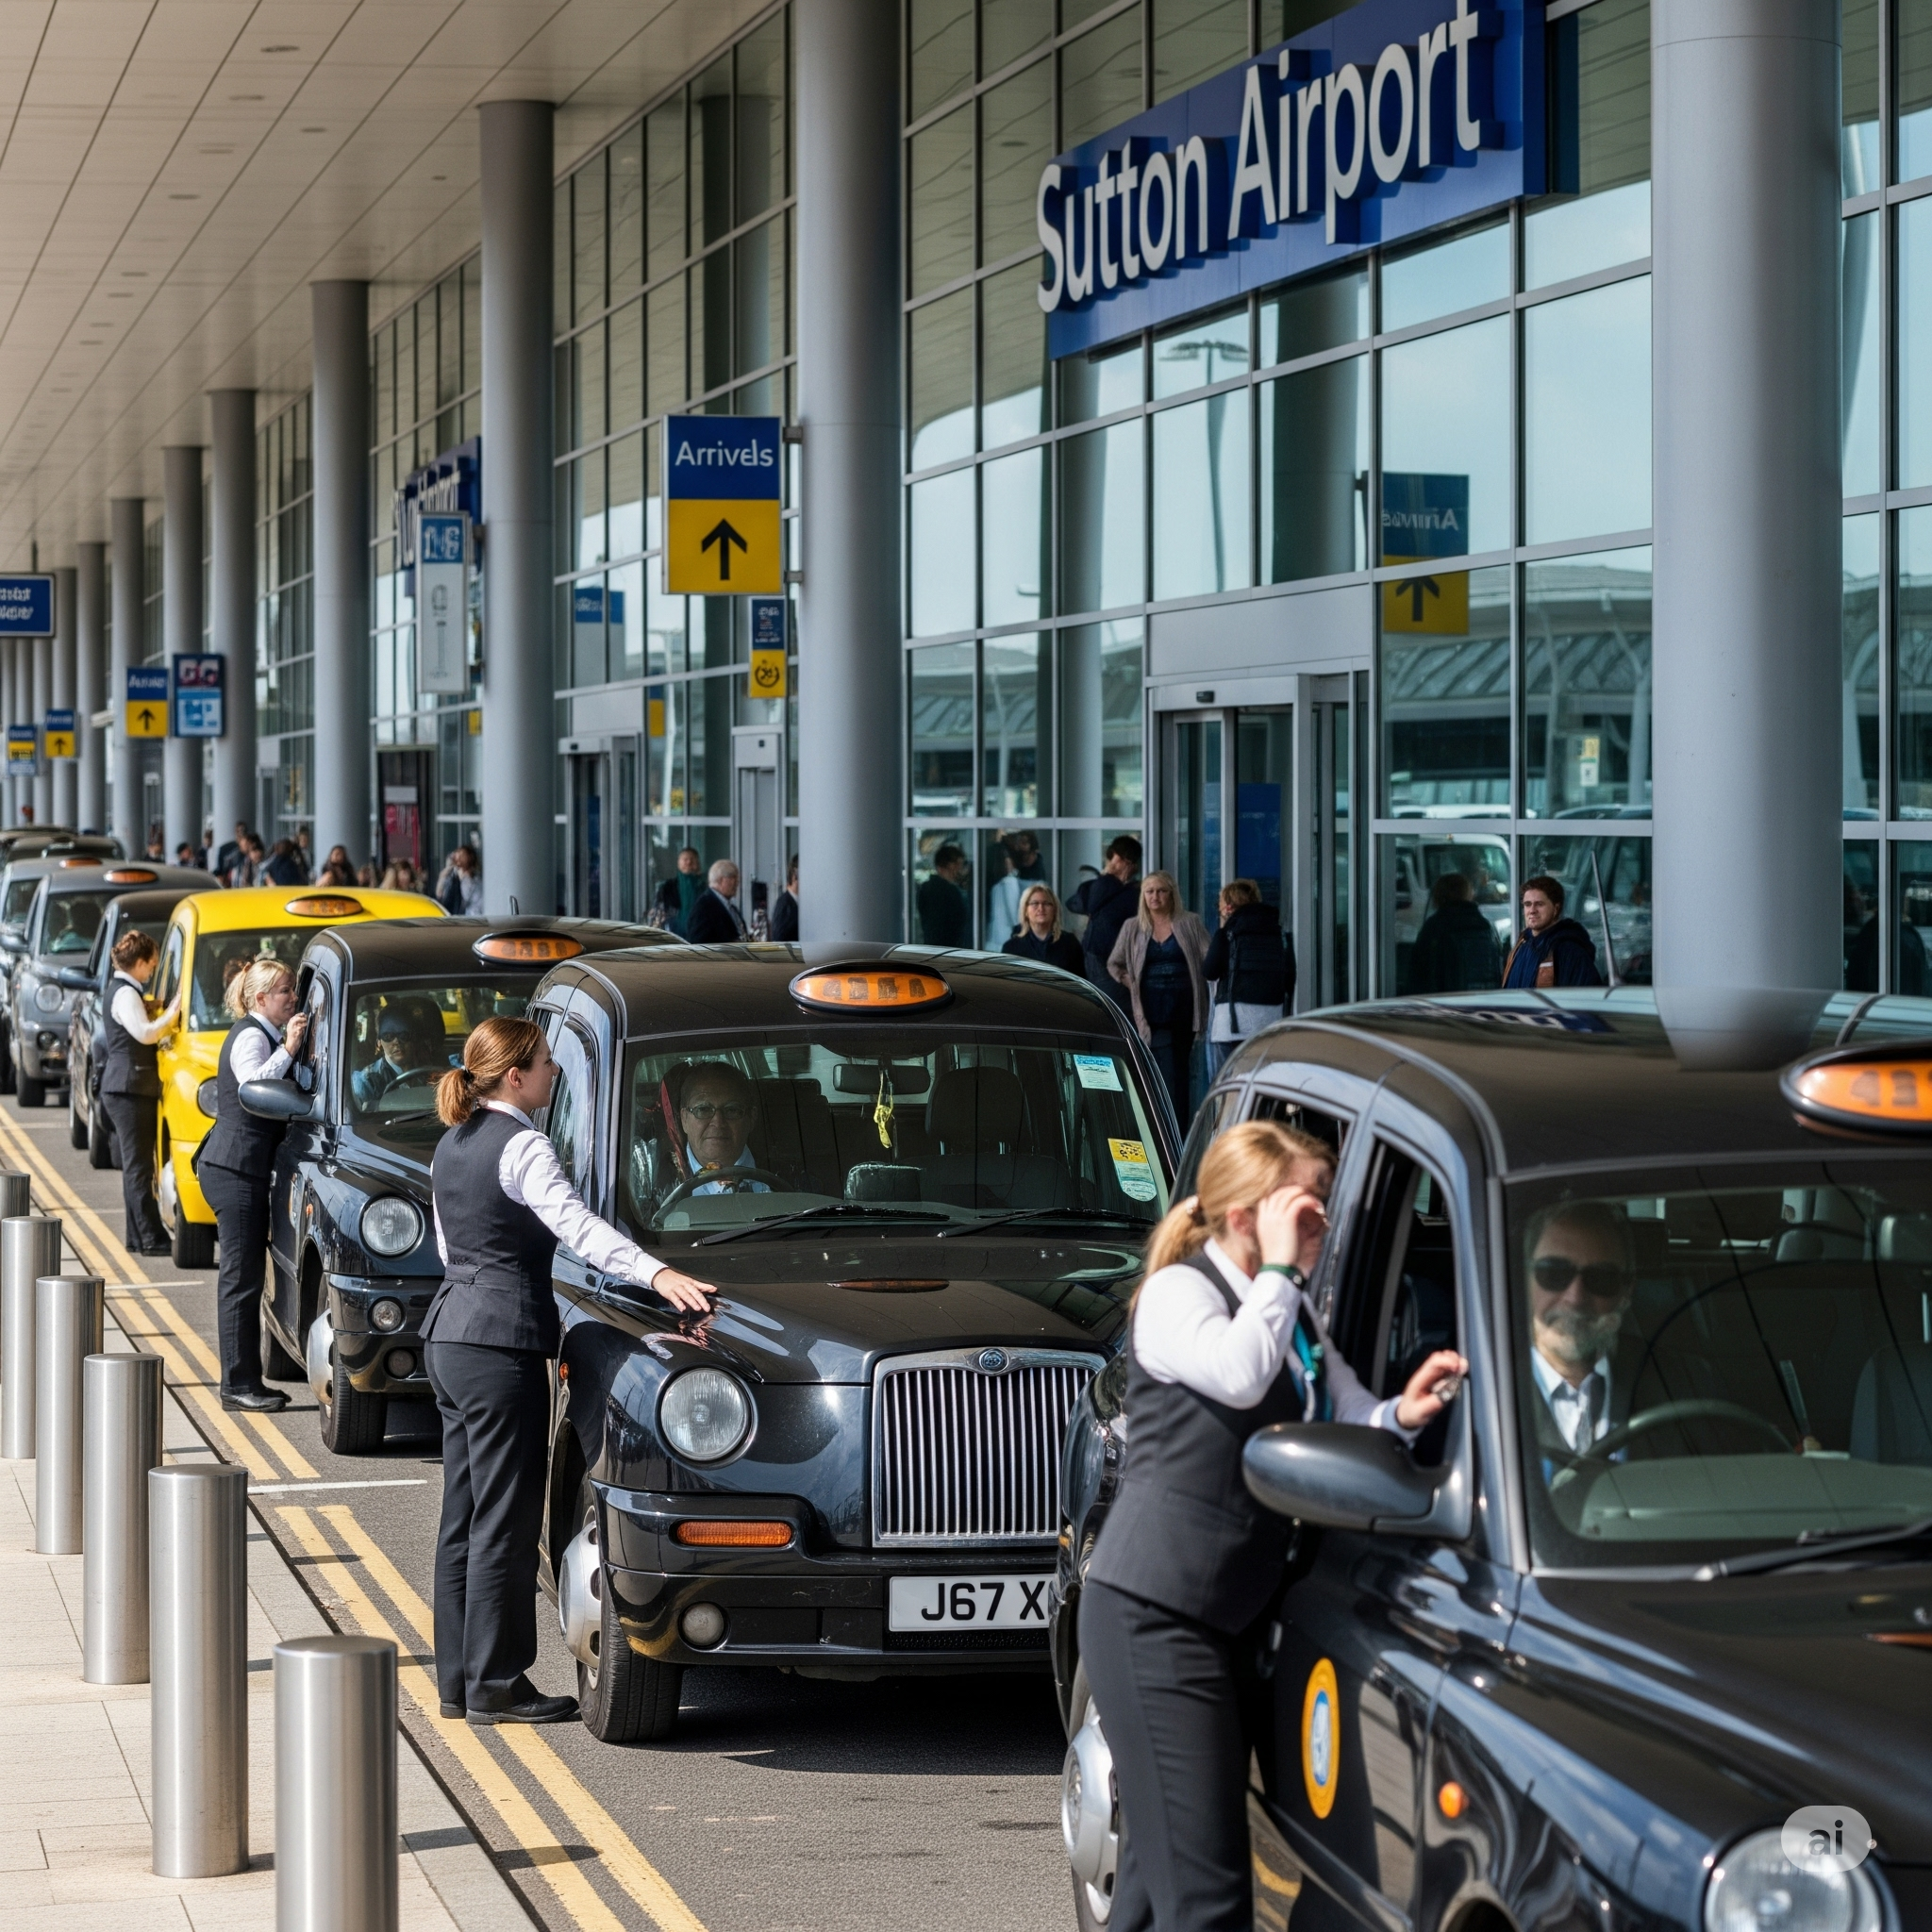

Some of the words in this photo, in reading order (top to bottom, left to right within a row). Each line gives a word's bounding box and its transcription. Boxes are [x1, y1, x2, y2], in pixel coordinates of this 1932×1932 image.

[1038, 135, 1208, 313] Sutton
[1228, 0, 1481, 245] Airport
[921, 1581, 1006, 1622] J67
